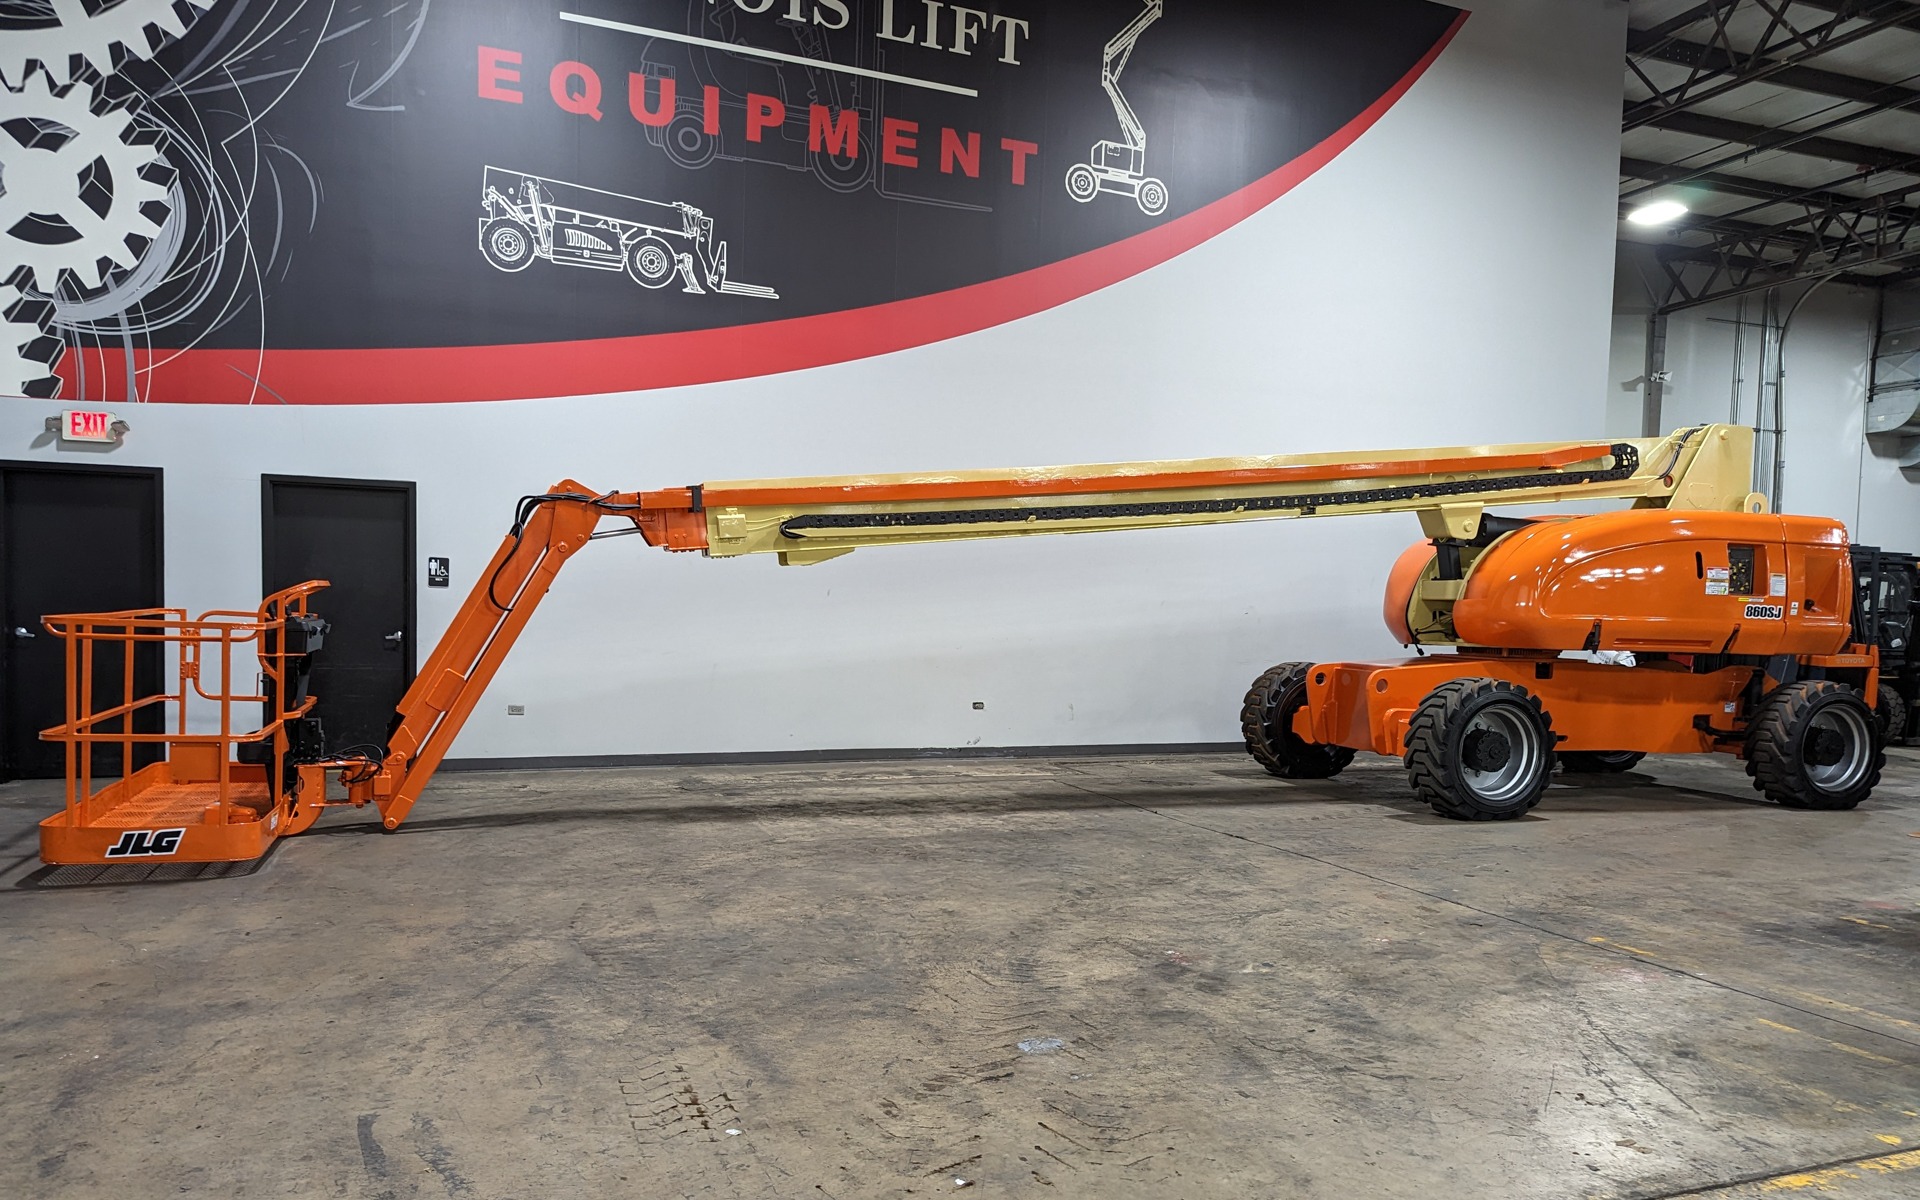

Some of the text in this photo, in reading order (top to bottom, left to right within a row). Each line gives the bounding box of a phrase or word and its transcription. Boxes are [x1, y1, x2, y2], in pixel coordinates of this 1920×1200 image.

[876, 0, 1029, 65] LIFT
[477, 46, 1037, 185] EQUIPMENT
[71, 411, 107, 438] EXIT
[1745, 604, 1783, 619] 860SJ
[106, 829, 185, 857] JLG
